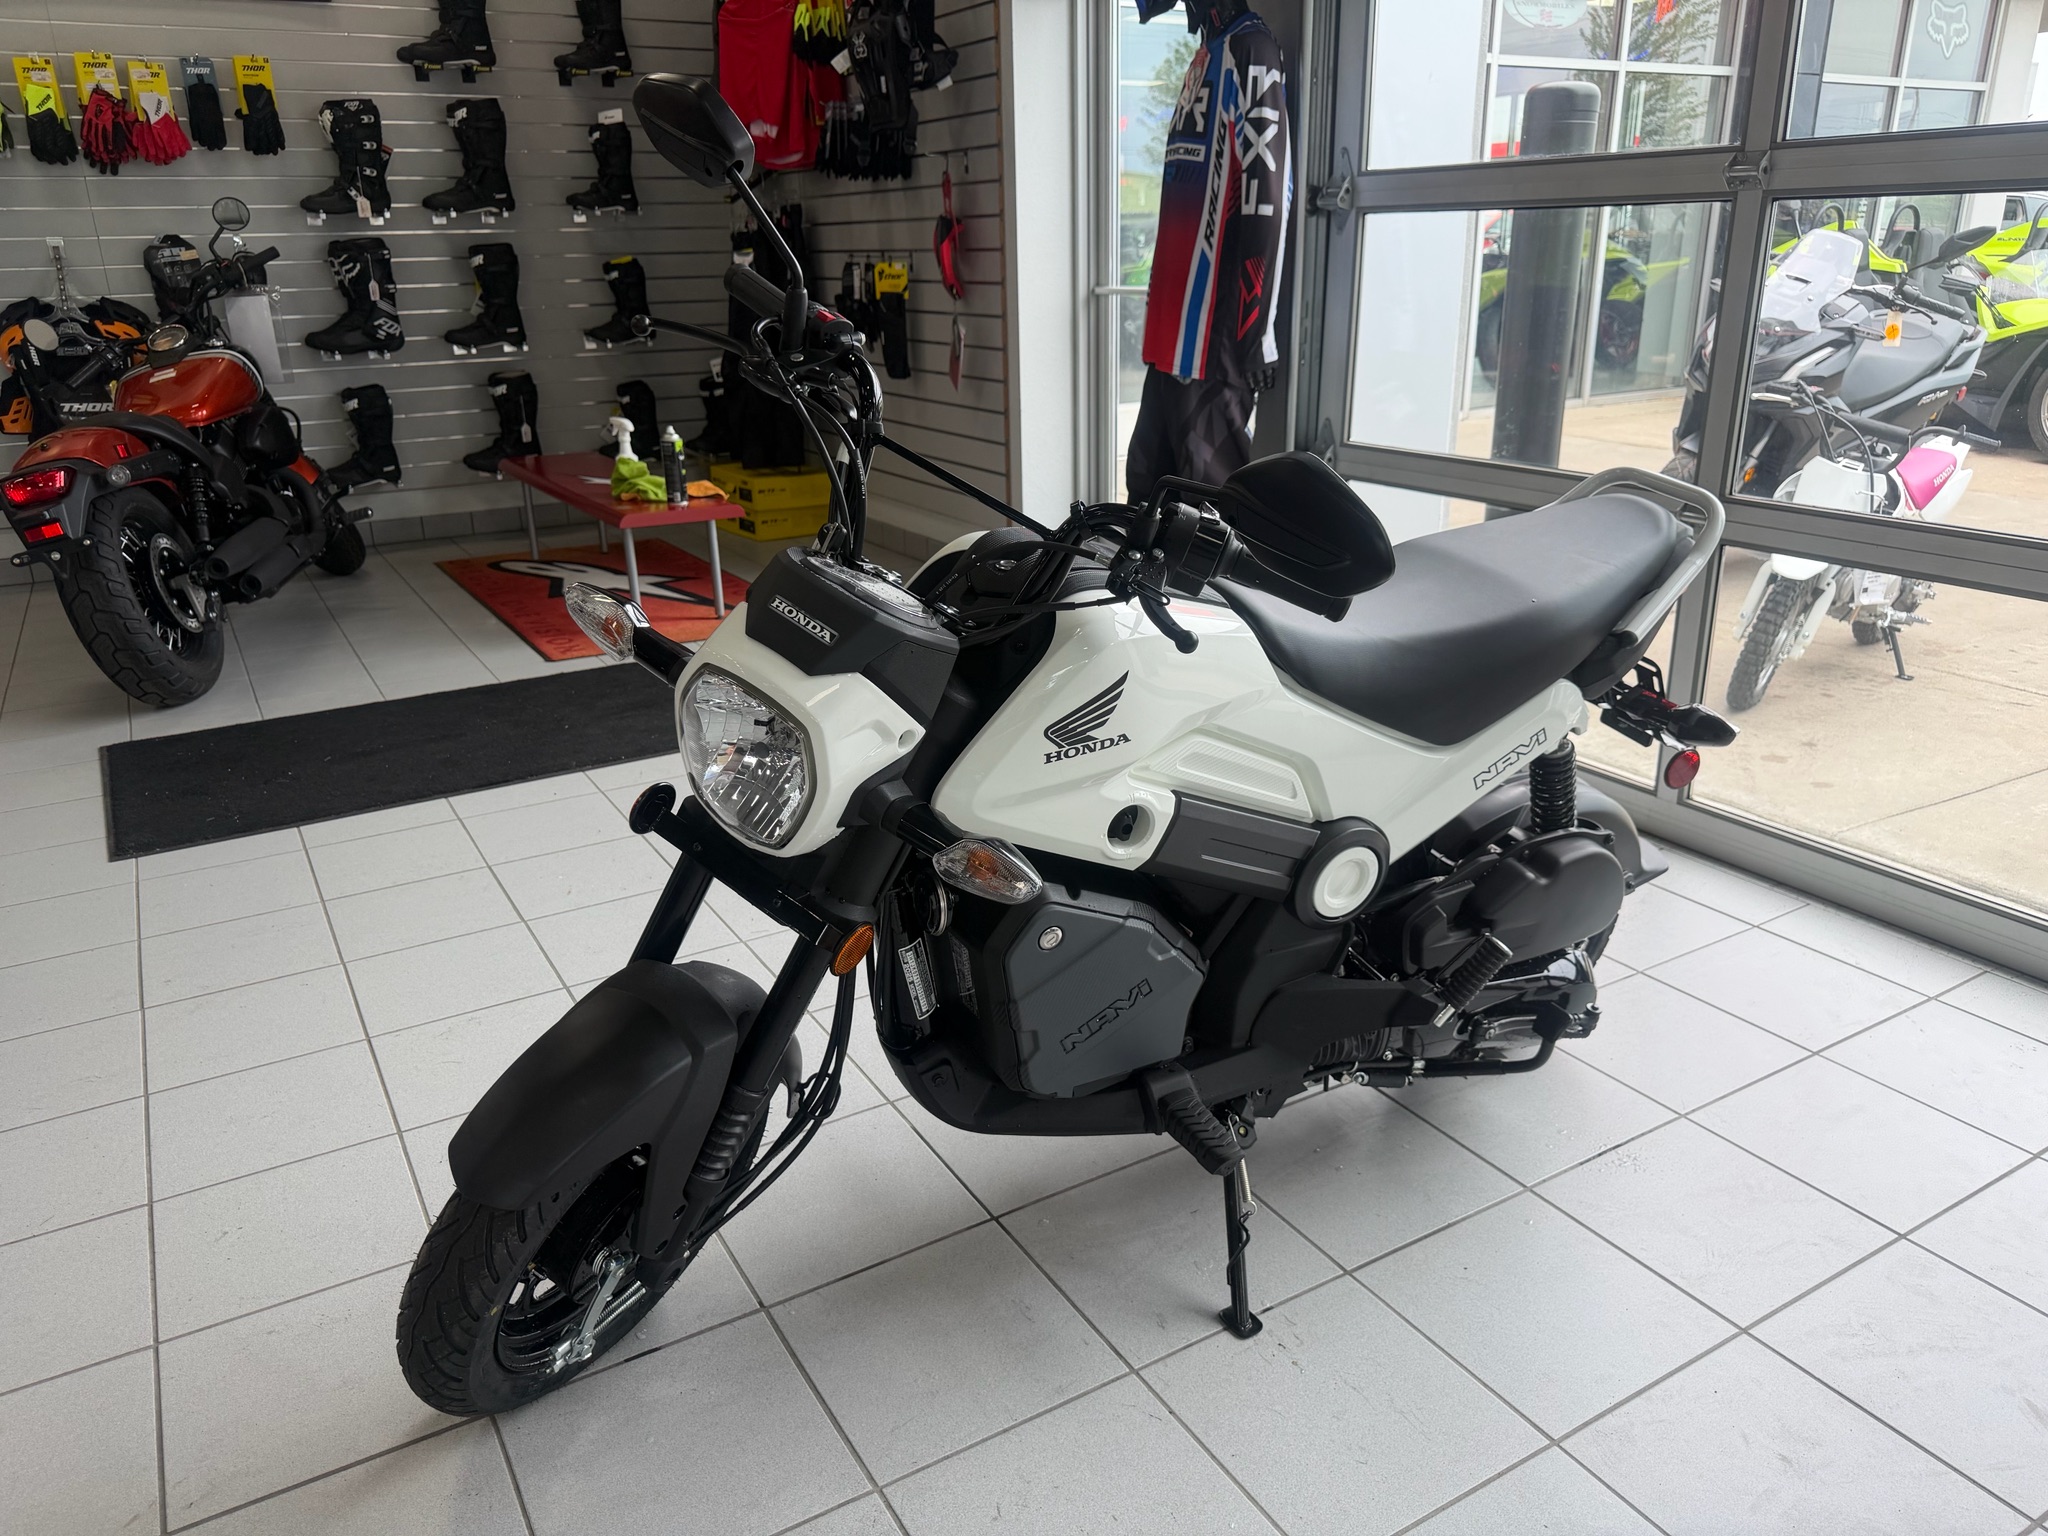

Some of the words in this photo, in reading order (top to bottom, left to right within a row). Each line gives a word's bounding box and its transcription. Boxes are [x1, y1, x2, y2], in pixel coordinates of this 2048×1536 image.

[82, 61, 108, 69] THOR
[36, 93, 52, 110] THOR
[155, 98, 163, 117] THOR
[1203, 119, 1227, 253] RACING
[373, 317, 402, 337] FOX
[60, 402, 114, 412] THOR
[1933, 463, 1955, 488] HONDA
[771, 598, 831, 643] HONDA
[1044, 733, 1131, 764] HONDA
[1473, 727, 1547, 790] NAVI
[1060, 978, 1152, 1054] NAVI
